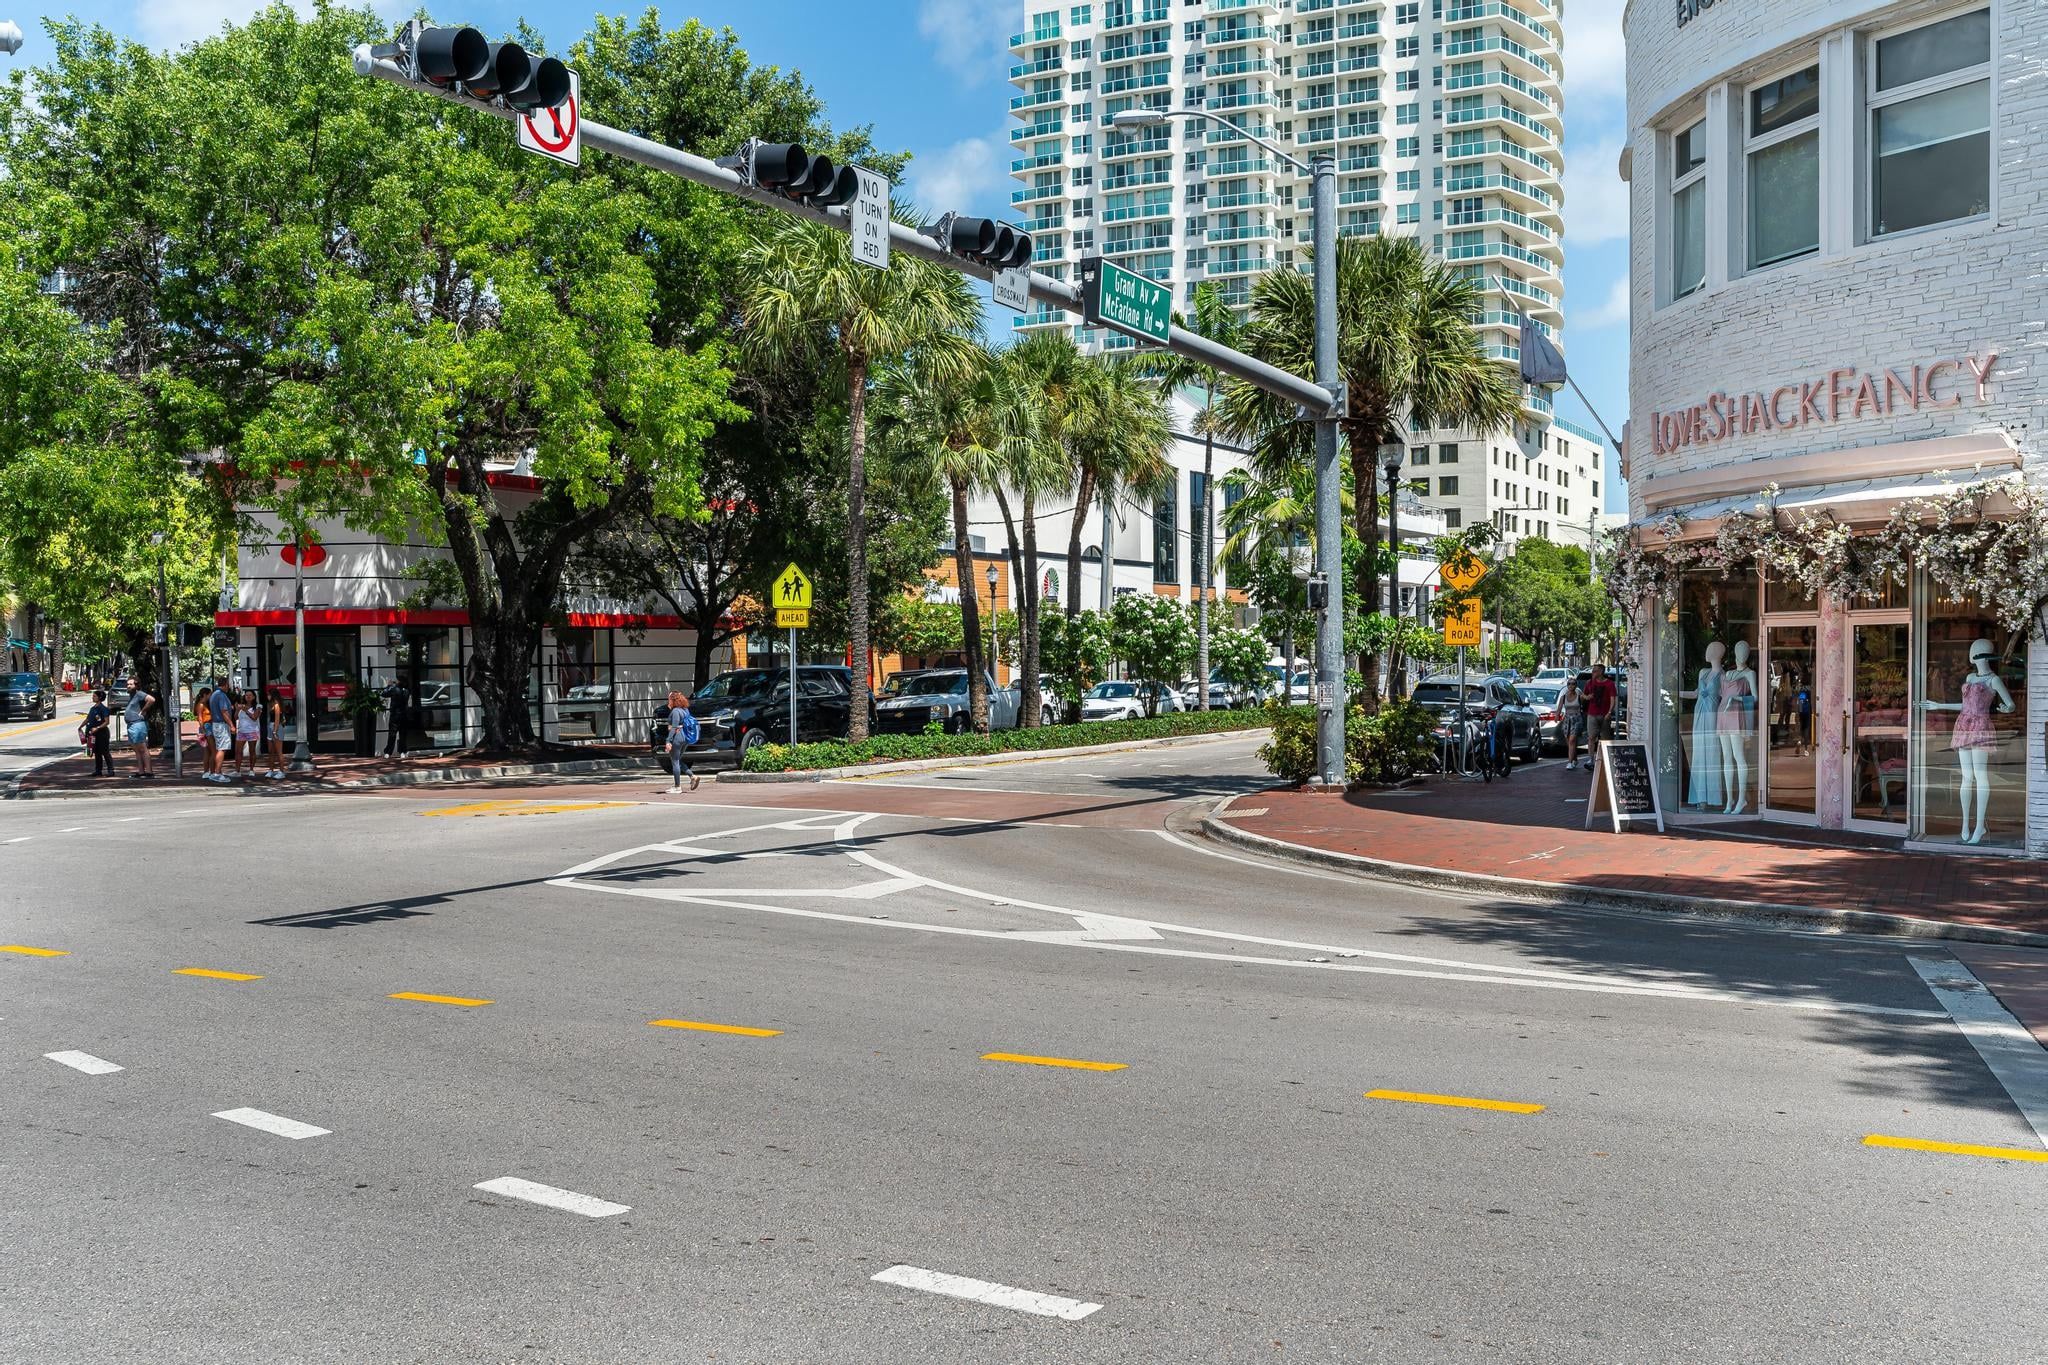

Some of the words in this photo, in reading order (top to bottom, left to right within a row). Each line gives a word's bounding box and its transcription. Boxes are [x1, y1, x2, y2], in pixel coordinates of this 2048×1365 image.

[863, 178, 878, 198] NO
[860, 200, 882, 220] TURN
[865, 222, 877, 239] ON
[863, 241, 879, 258] RED
[997, 285, 1025, 305] CROSSWALK
[1114, 270, 1136, 299] Grand
[1140, 281, 1149, 305] Av
[1104, 292, 1140, 327] McFarlane
[1143, 308, 1154, 332] Rd
[781, 613, 805, 622] AHEAD
[1456, 617, 1471, 626] THE
[1451, 630, 1474, 639] ROAD
